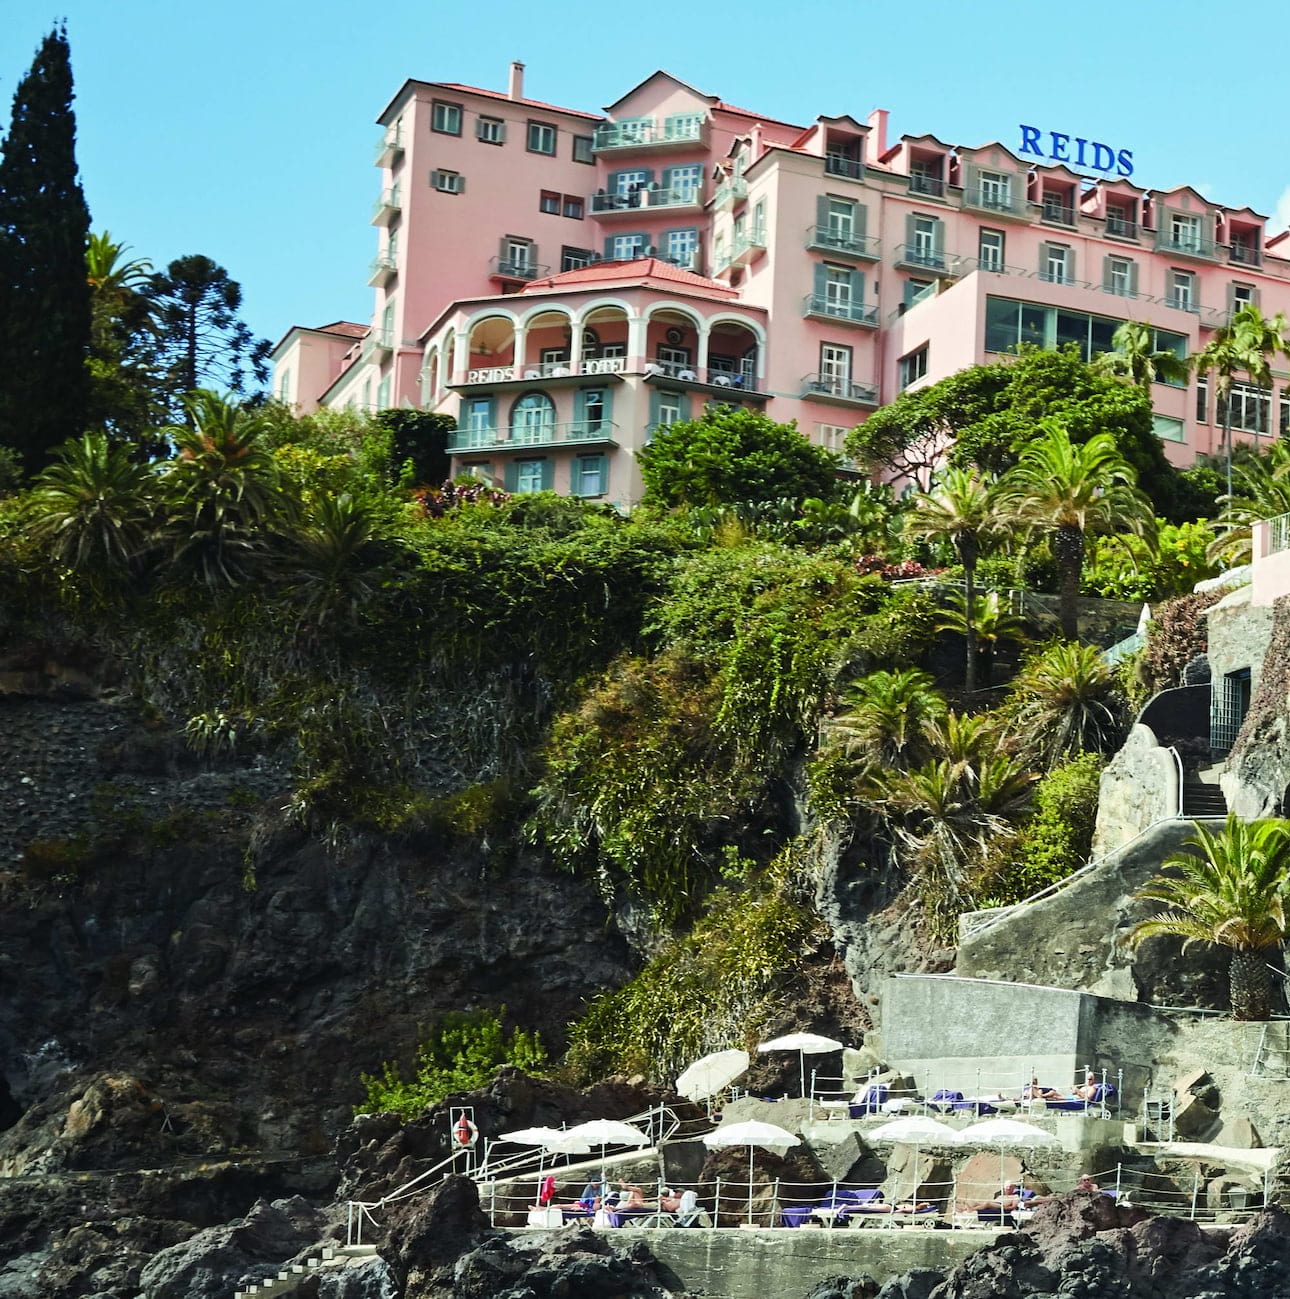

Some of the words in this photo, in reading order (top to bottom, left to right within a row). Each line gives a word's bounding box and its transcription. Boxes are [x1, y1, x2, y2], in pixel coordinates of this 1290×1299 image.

[1019, 124, 1134, 177] REIDS
[468, 368, 515, 385] REIDS
[579, 359, 625, 375] HOTEL
